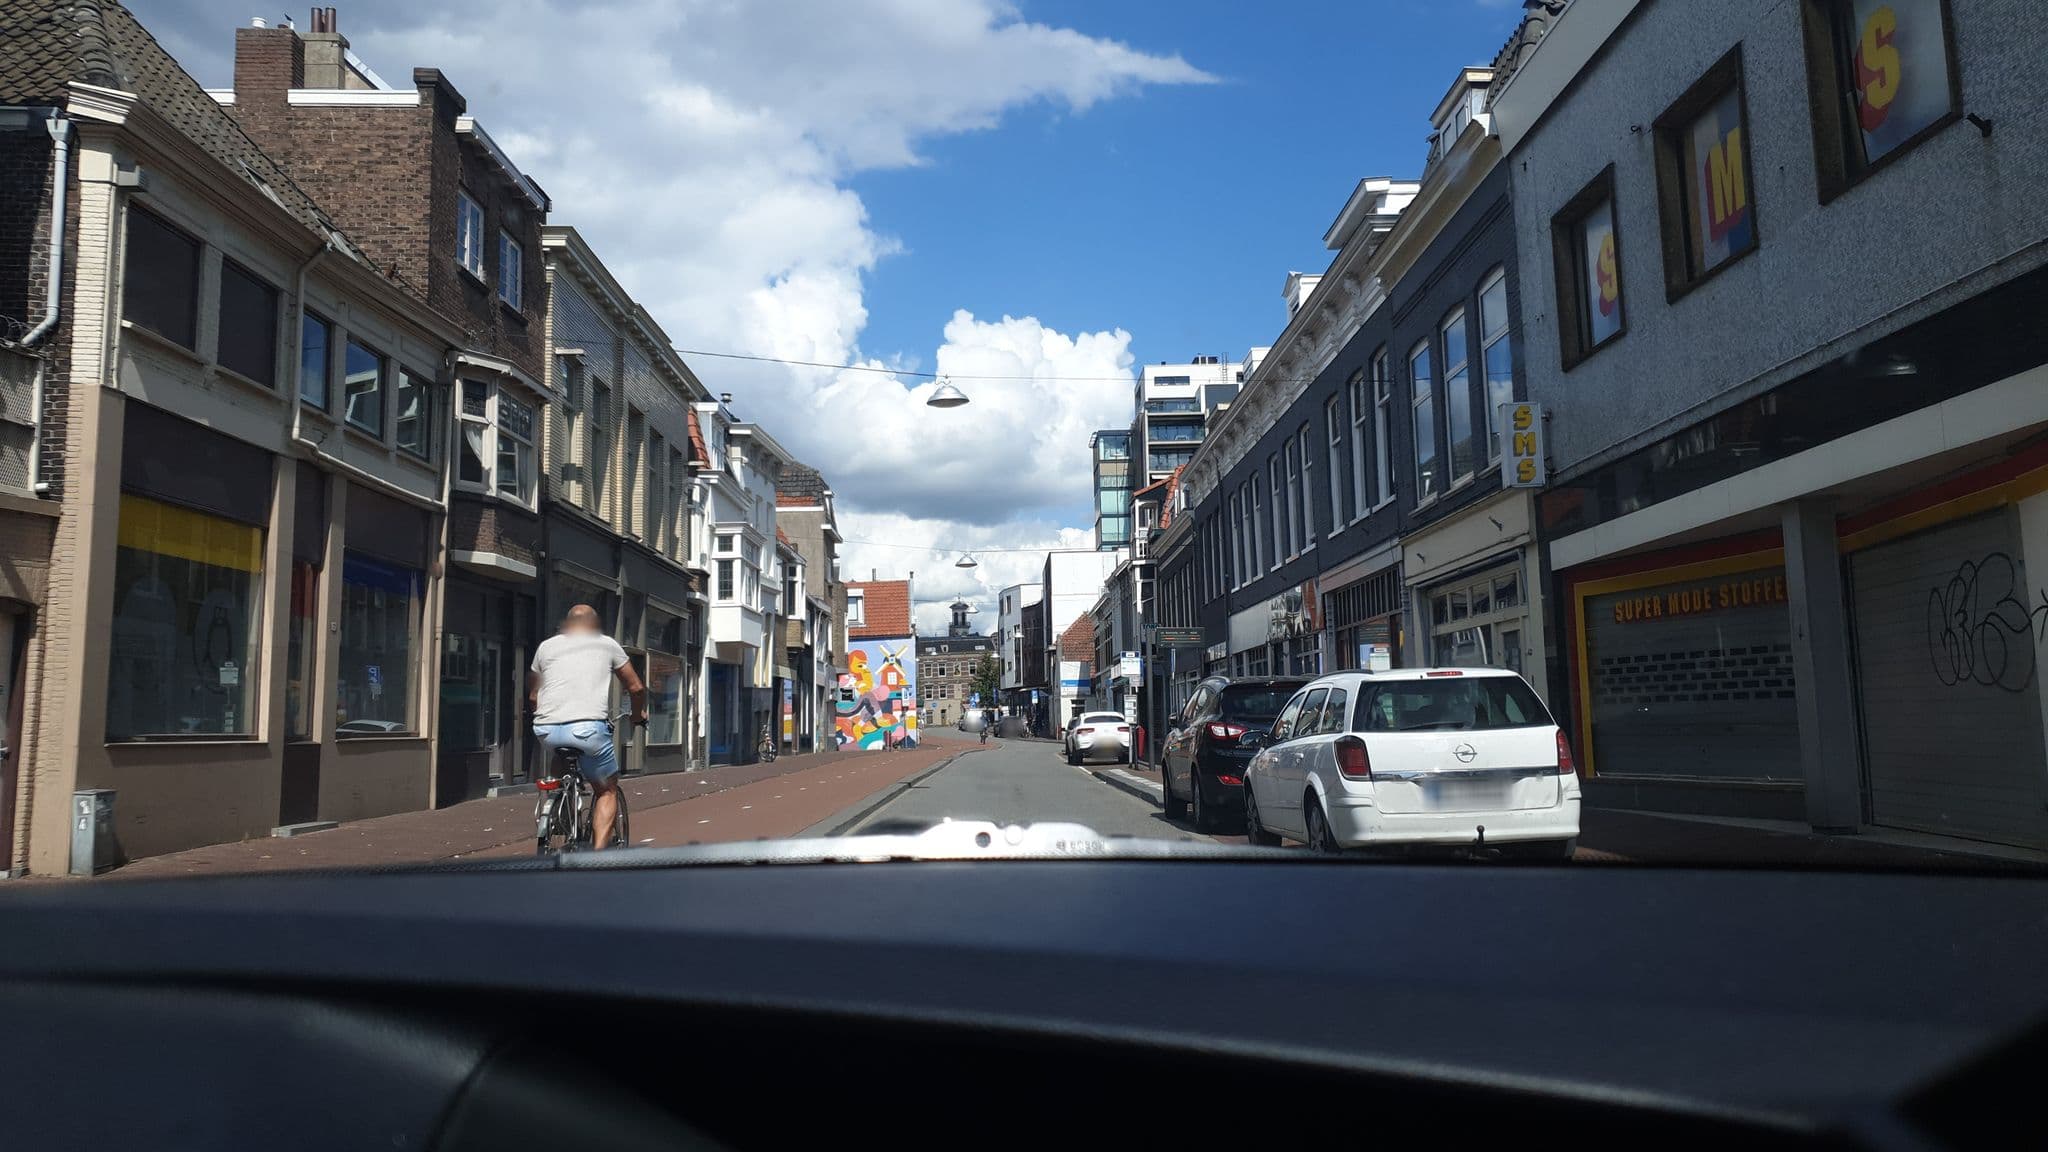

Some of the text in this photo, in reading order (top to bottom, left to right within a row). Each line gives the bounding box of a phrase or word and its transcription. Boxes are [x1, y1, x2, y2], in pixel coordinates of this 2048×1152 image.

[1707, 128, 1745, 231] M
[1859, 5, 1901, 119] S
[1513, 405, 1537, 483] SMS
[1615, 594, 1664, 622] SUPER
[1669, 588, 1712, 615] MODE
